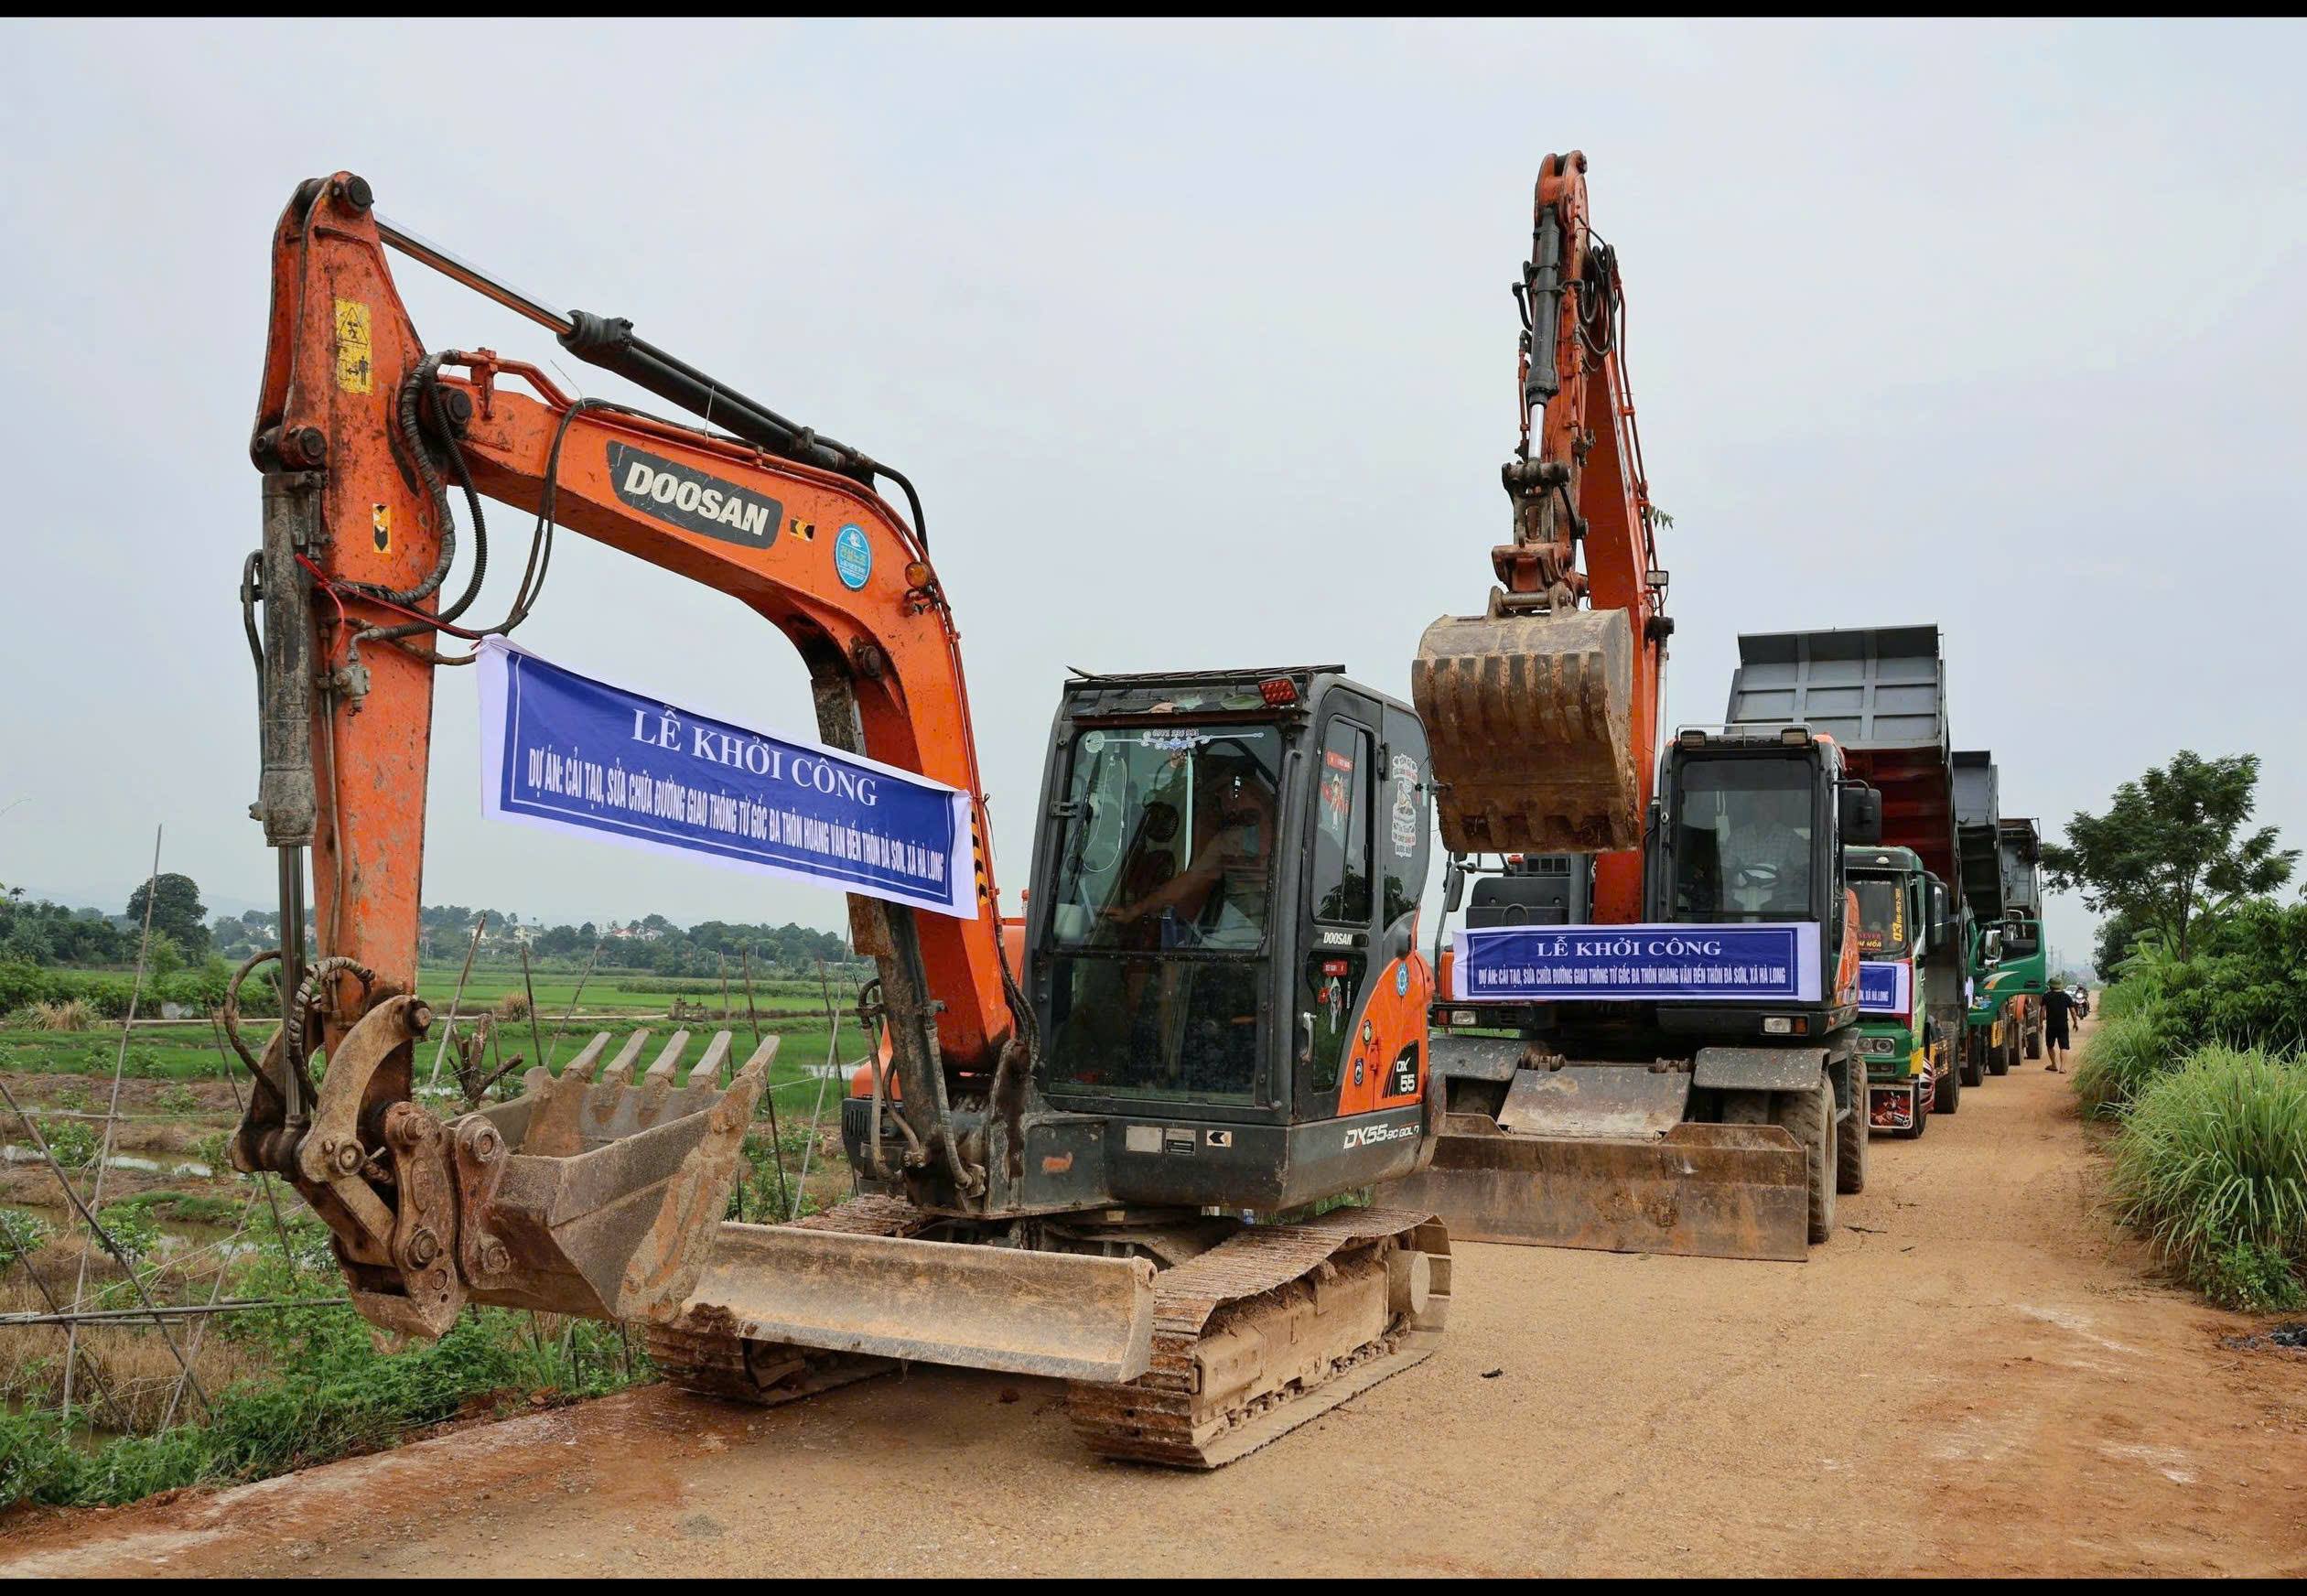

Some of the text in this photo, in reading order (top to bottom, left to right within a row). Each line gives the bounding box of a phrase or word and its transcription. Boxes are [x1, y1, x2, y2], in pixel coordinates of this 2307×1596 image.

[623, 461, 770, 536] DOOSAN
[631, 704, 878, 807] LỄ KHỞI CÔNG
[528, 746, 544, 798] DỰ
[544, 744, 563, 793] ÁN:
[565, 746, 583, 798] CẢI
[585, 761, 604, 810] TẠO,
[608, 757, 626, 808] SỬA
[629, 769, 652, 814] CHỮA
[654, 774, 685, 822] ĐƯỜNG
[686, 788, 707, 827] GIAO
[709, 788, 737, 834] THÔNG
[738, 794, 751, 836] TỪ
[750, 793, 768, 840] GỐC
[782, 806, 803, 848] THÔN
[830, 818, 846, 858] VÂN
[846, 820, 862, 862] ĐẾN
[862, 827, 880, 867] THÔN
[927, 850, 944, 882] LONG
[1323, 932, 1353, 945] DOOSAN
[1537, 935, 1721, 956] LỄ KHỞI CÔNG
[1574, 968, 1588, 985] GIAO
[1589, 965, 1609, 985] THÔNG
[1770, 967, 1786, 984] LONG
[1396, 1057, 1411, 1073] DX
[1400, 1073, 1416, 1092] 55
